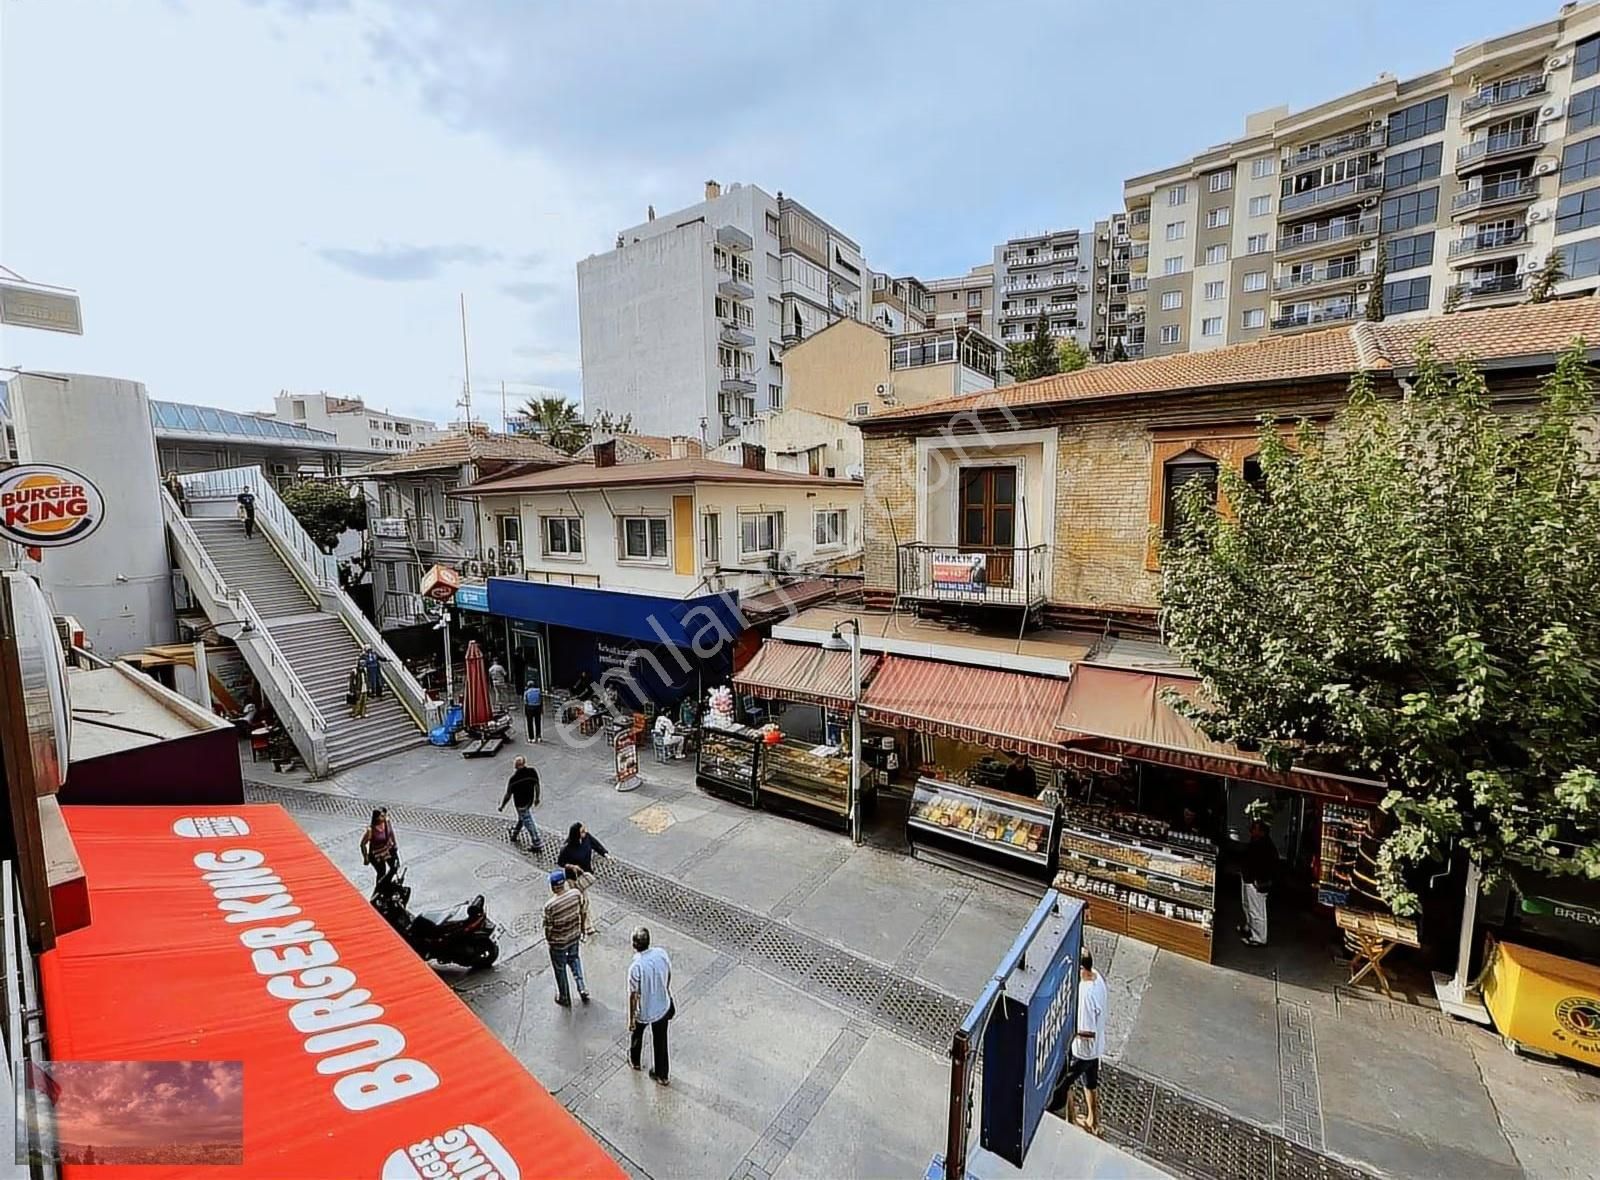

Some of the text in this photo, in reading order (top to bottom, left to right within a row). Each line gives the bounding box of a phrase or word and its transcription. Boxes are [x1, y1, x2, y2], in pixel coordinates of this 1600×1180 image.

[2, 485, 84, 507] BURGER
[5, 498, 88, 527] KING
[193, 848, 441, 1112] BURGER KING
[432, 1128, 500, 1180] ING
